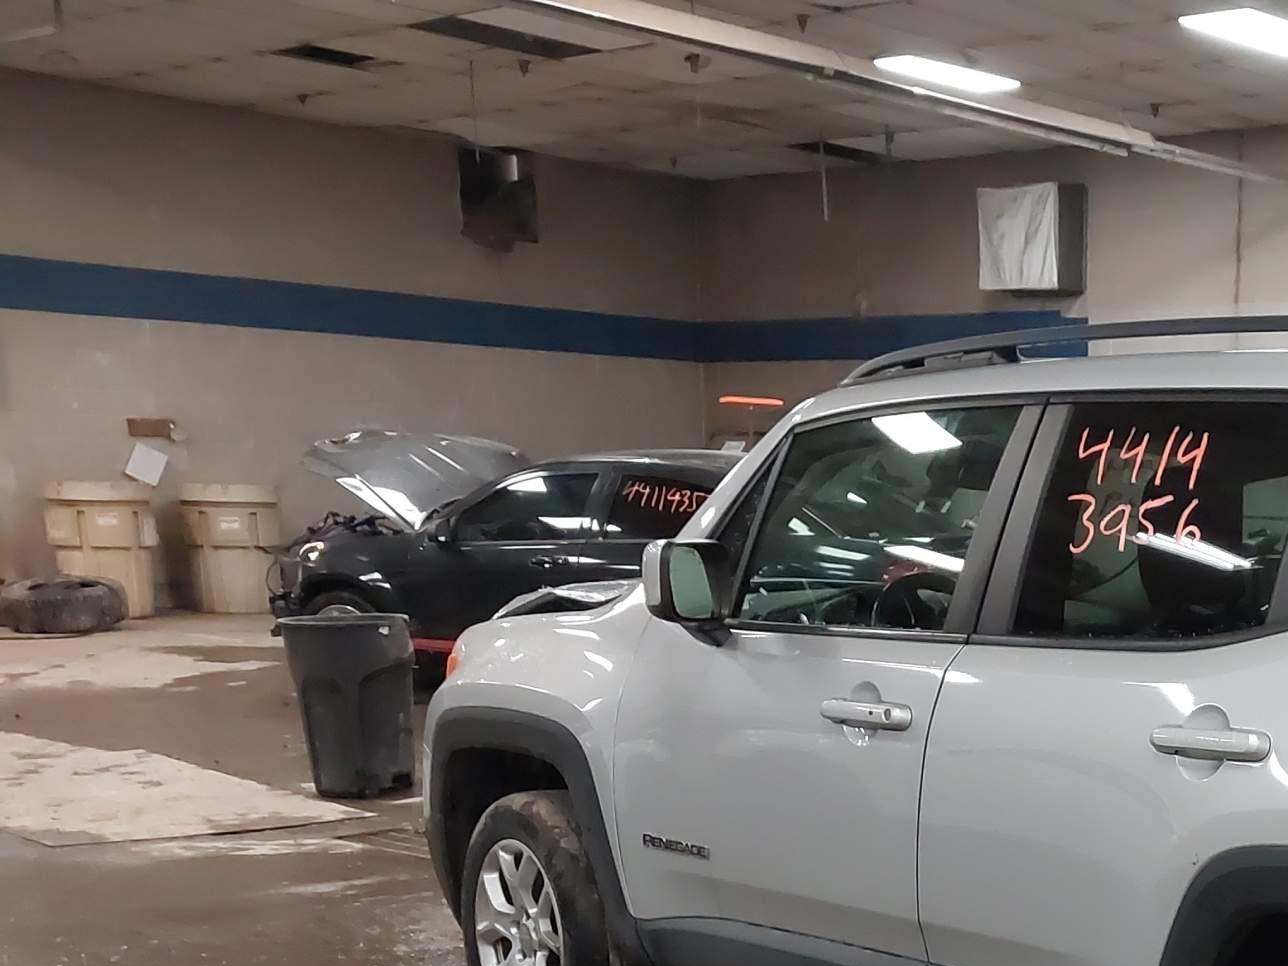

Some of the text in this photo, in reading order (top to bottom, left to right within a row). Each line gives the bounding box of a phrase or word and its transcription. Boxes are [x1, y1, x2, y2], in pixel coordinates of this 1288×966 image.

[1078, 425, 1210, 491] 4414
[1067, 494, 1202, 554] 3956
[642, 832, 711, 861] RENEGADE
